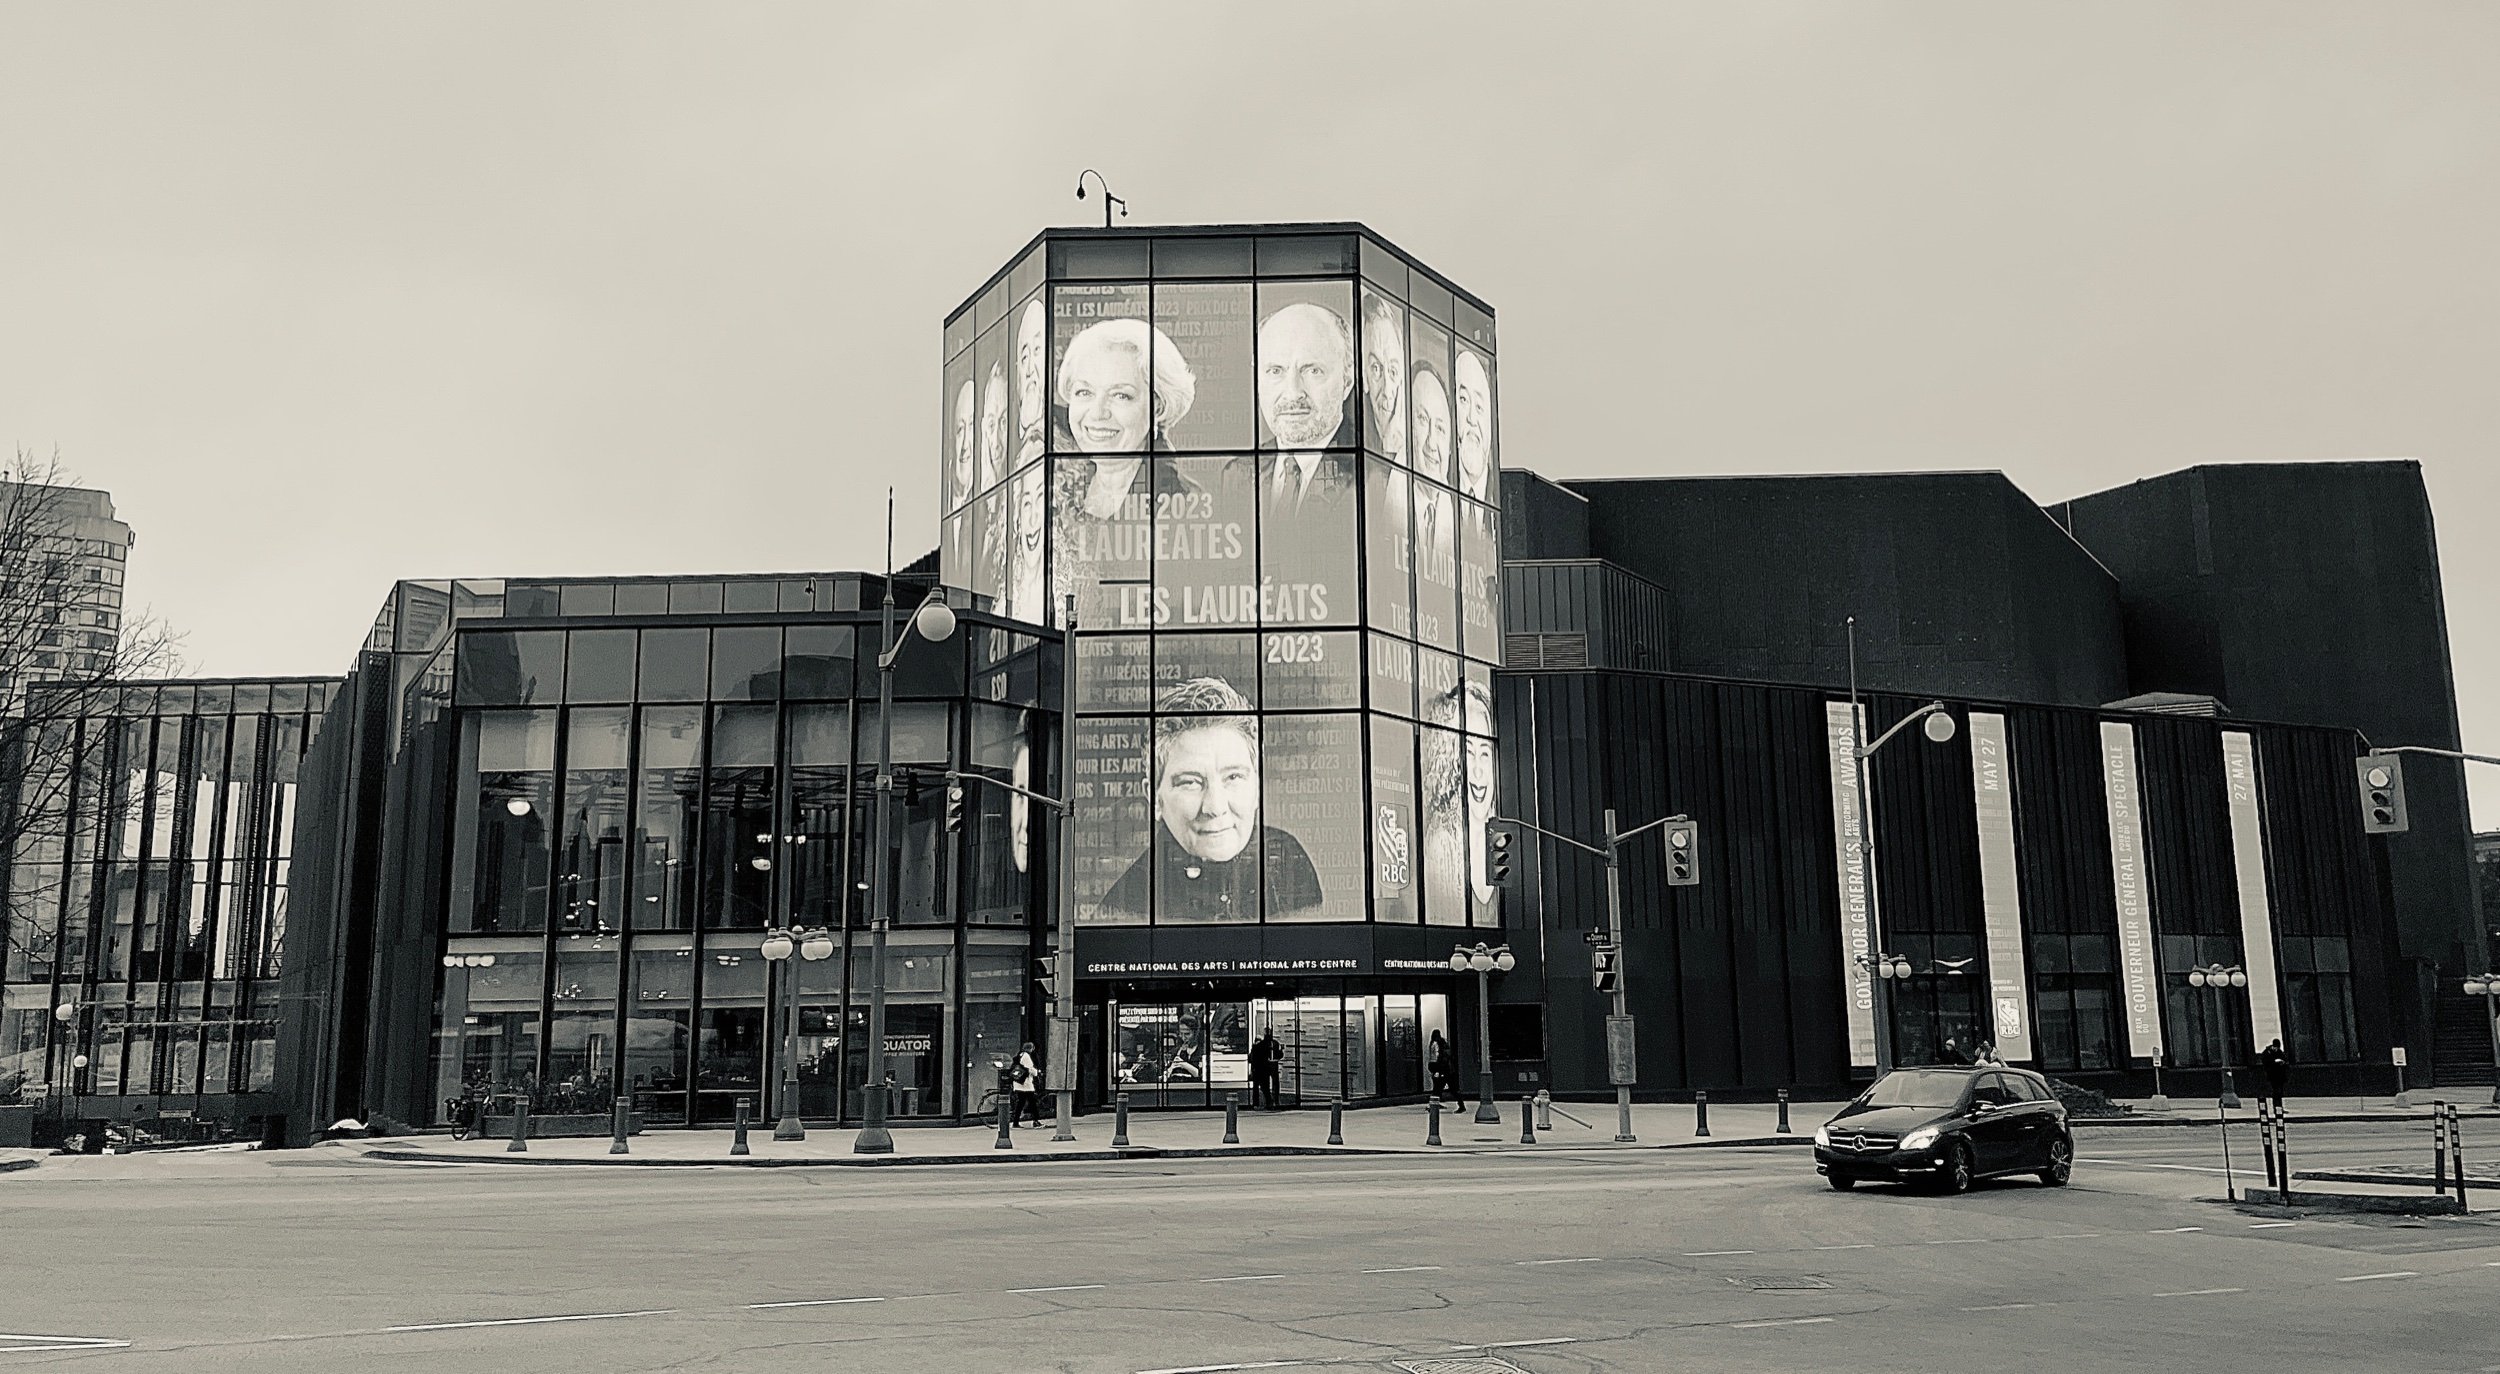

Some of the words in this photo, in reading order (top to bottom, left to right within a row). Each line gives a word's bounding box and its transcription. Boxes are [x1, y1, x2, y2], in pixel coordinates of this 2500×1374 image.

[1077, 302, 1096, 317] LES
[1097, 298, 1149, 317] LAURÉATS
[1174, 321, 1202, 337] ARTS
[1156, 492, 1213, 520] 2023
[1078, 522, 1243, 561] LAUREATES
[1393, 534, 1410, 573] LE
[1423, 546, 1487, 600] LAURATS
[1120, 585, 1171, 625] LES
[1183, 576, 1329, 624] LAURÉATS
[1463, 598, 1489, 629] 2023
[1267, 634, 1324, 663] 2023
[1375, 638, 1451, 694] LAURATES
[1101, 733, 1130, 749] ARTS
[1981, 737, 1996, 756] 27
[1101, 758, 1120, 774] LES
[1309, 754, 1340, 770] 2023
[1838, 727, 1858, 788] AWARDS
[2231, 753, 2245, 779] MAI
[1983, 760, 1998, 791] MAY
[2110, 744, 2129, 818] SPECTACLE
[1103, 781, 1125, 797] THE
[2233, 783, 2247, 801] 27
[1288, 802, 1320, 819] POUR
[1321, 802, 1341, 818] LES
[1843, 792, 1852, 837] PERFORMING
[1852, 818, 1860, 837] ARTS
[2118, 832, 2126, 852] POUR
[2123, 835, 2132, 852] ARTS
[1382, 863, 1407, 884] RBC
[1846, 842, 1867, 922] GENERAL'S
[2119, 855, 2138, 916] GÉNÉRAL
[1087, 963, 1127, 973] CENTRE
[1129, 962, 1178, 972] NATIONAL
[1181, 962, 1201, 971] DES
[1203, 961, 1229, 970] ARTS
[1239, 960, 1290, 970] NATIONAL
[1292, 960, 1318, 969] ARTS
[1319, 959, 1358, 969] CENTRE
[1384, 959, 1403, 969] CENTRE
[1403, 960, 1427, 969] NATIONAL
[1426, 960, 1437, 969] DES
[2126, 920, 2147, 1013] GOUVERNEUR
[2001, 1025, 2019, 1035] RBC
[2135, 1017, 2143, 1034] PRIX
[2142, 1023, 2150, 1034] DU
[883, 1040, 931, 1051] QUATOR
